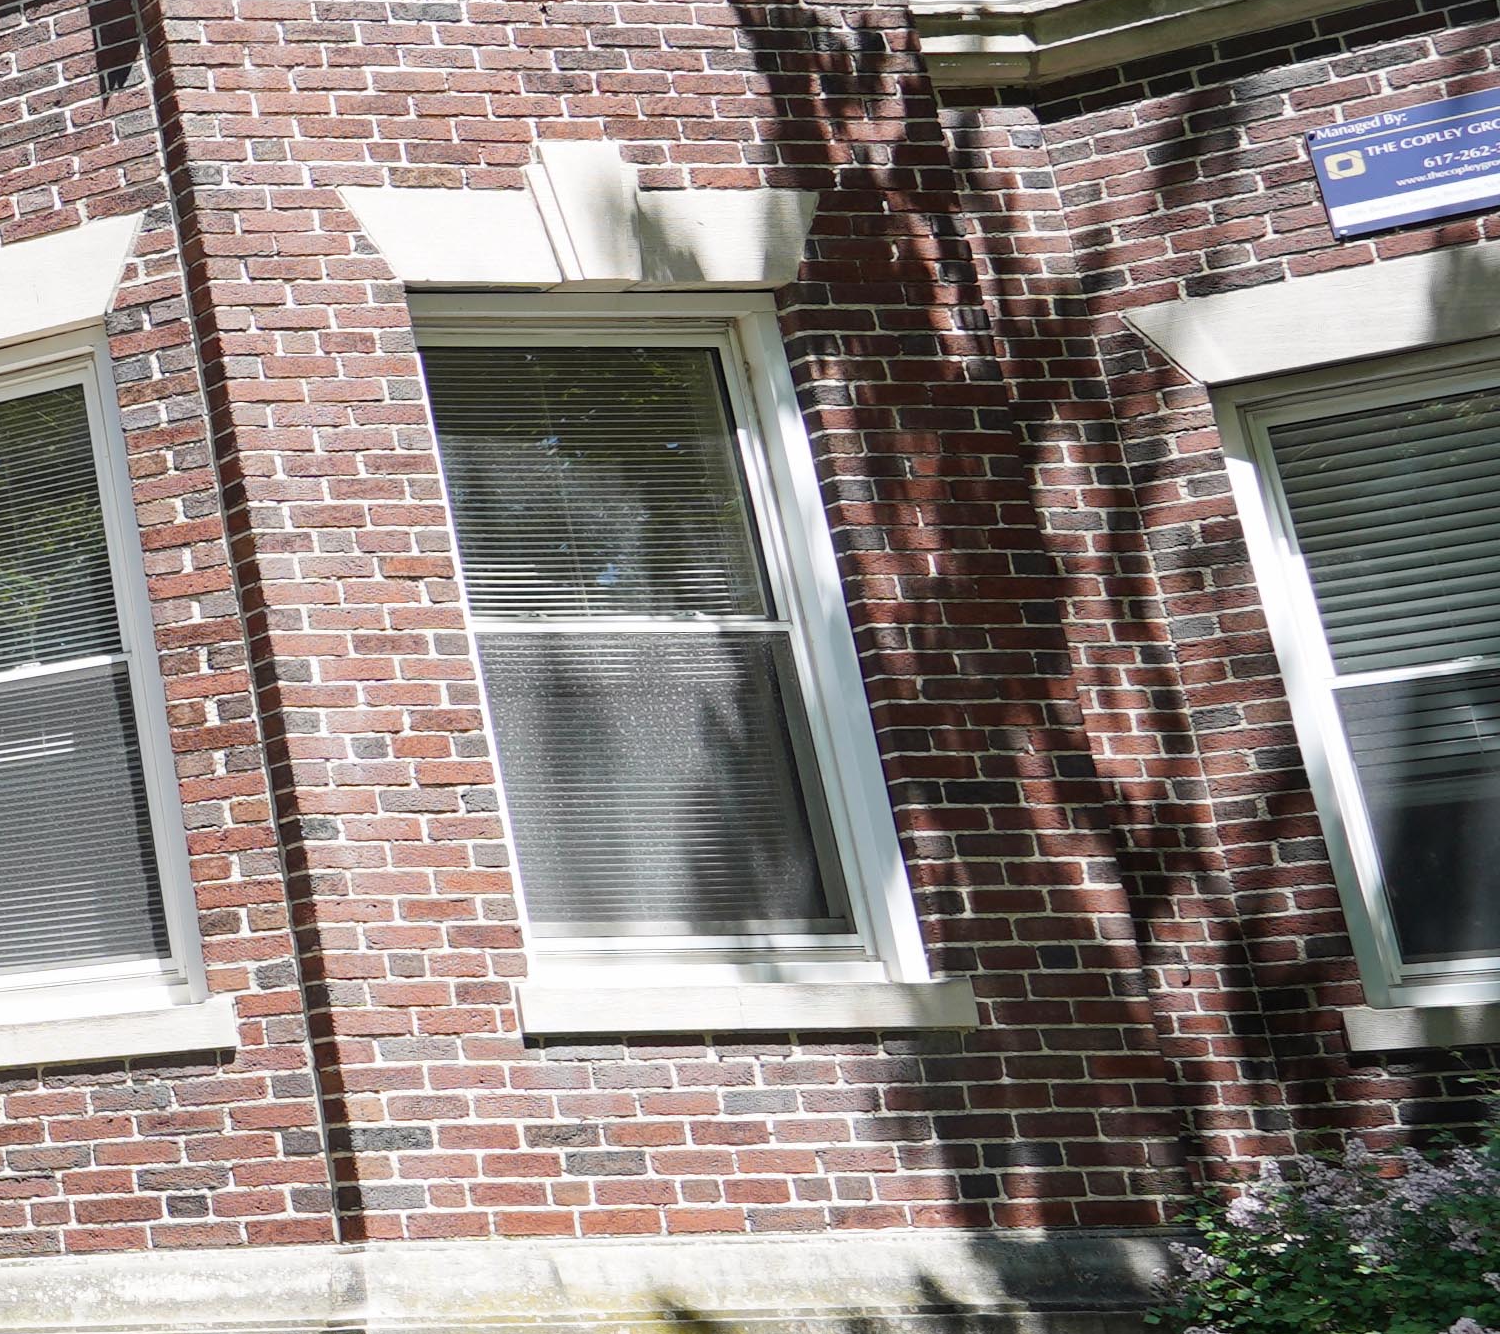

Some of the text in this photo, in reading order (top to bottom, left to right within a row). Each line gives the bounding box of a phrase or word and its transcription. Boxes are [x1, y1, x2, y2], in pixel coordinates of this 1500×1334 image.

[1316, 113, 1408, 140] Managed By:
[1364, 141, 1398, 157] THE
[1400, 126, 1463, 149] COPLEY
